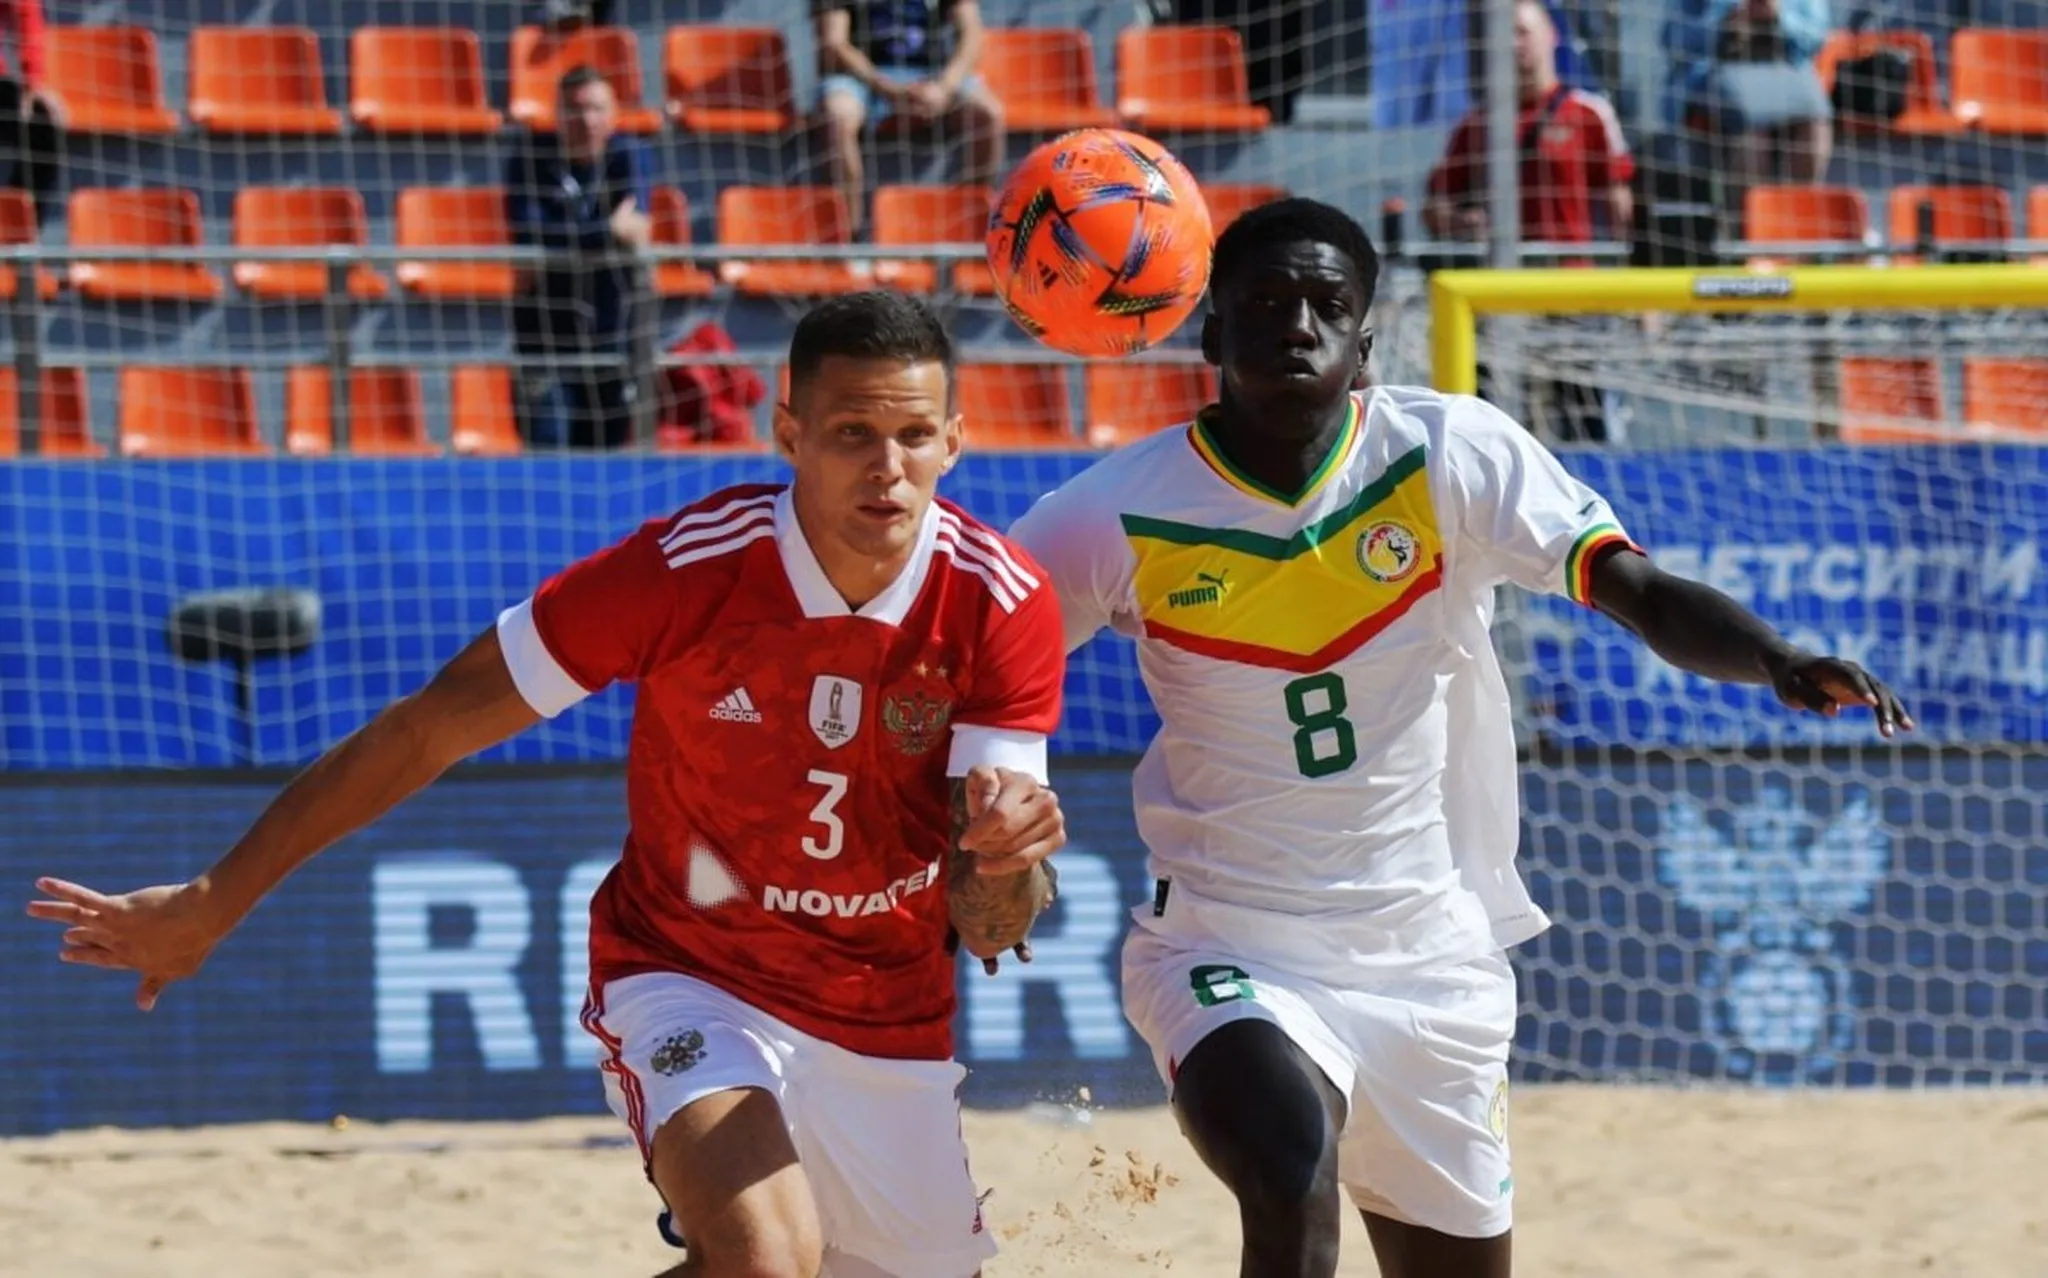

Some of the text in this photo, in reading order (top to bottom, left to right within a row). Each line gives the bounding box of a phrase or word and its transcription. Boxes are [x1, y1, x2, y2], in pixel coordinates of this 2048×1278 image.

[1167, 585, 1218, 609] PUMA
[709, 706, 762, 723] adidas
[1284, 671, 1357, 778] 8
[801, 768, 848, 860] 3
[1189, 964, 1257, 1007] 8
